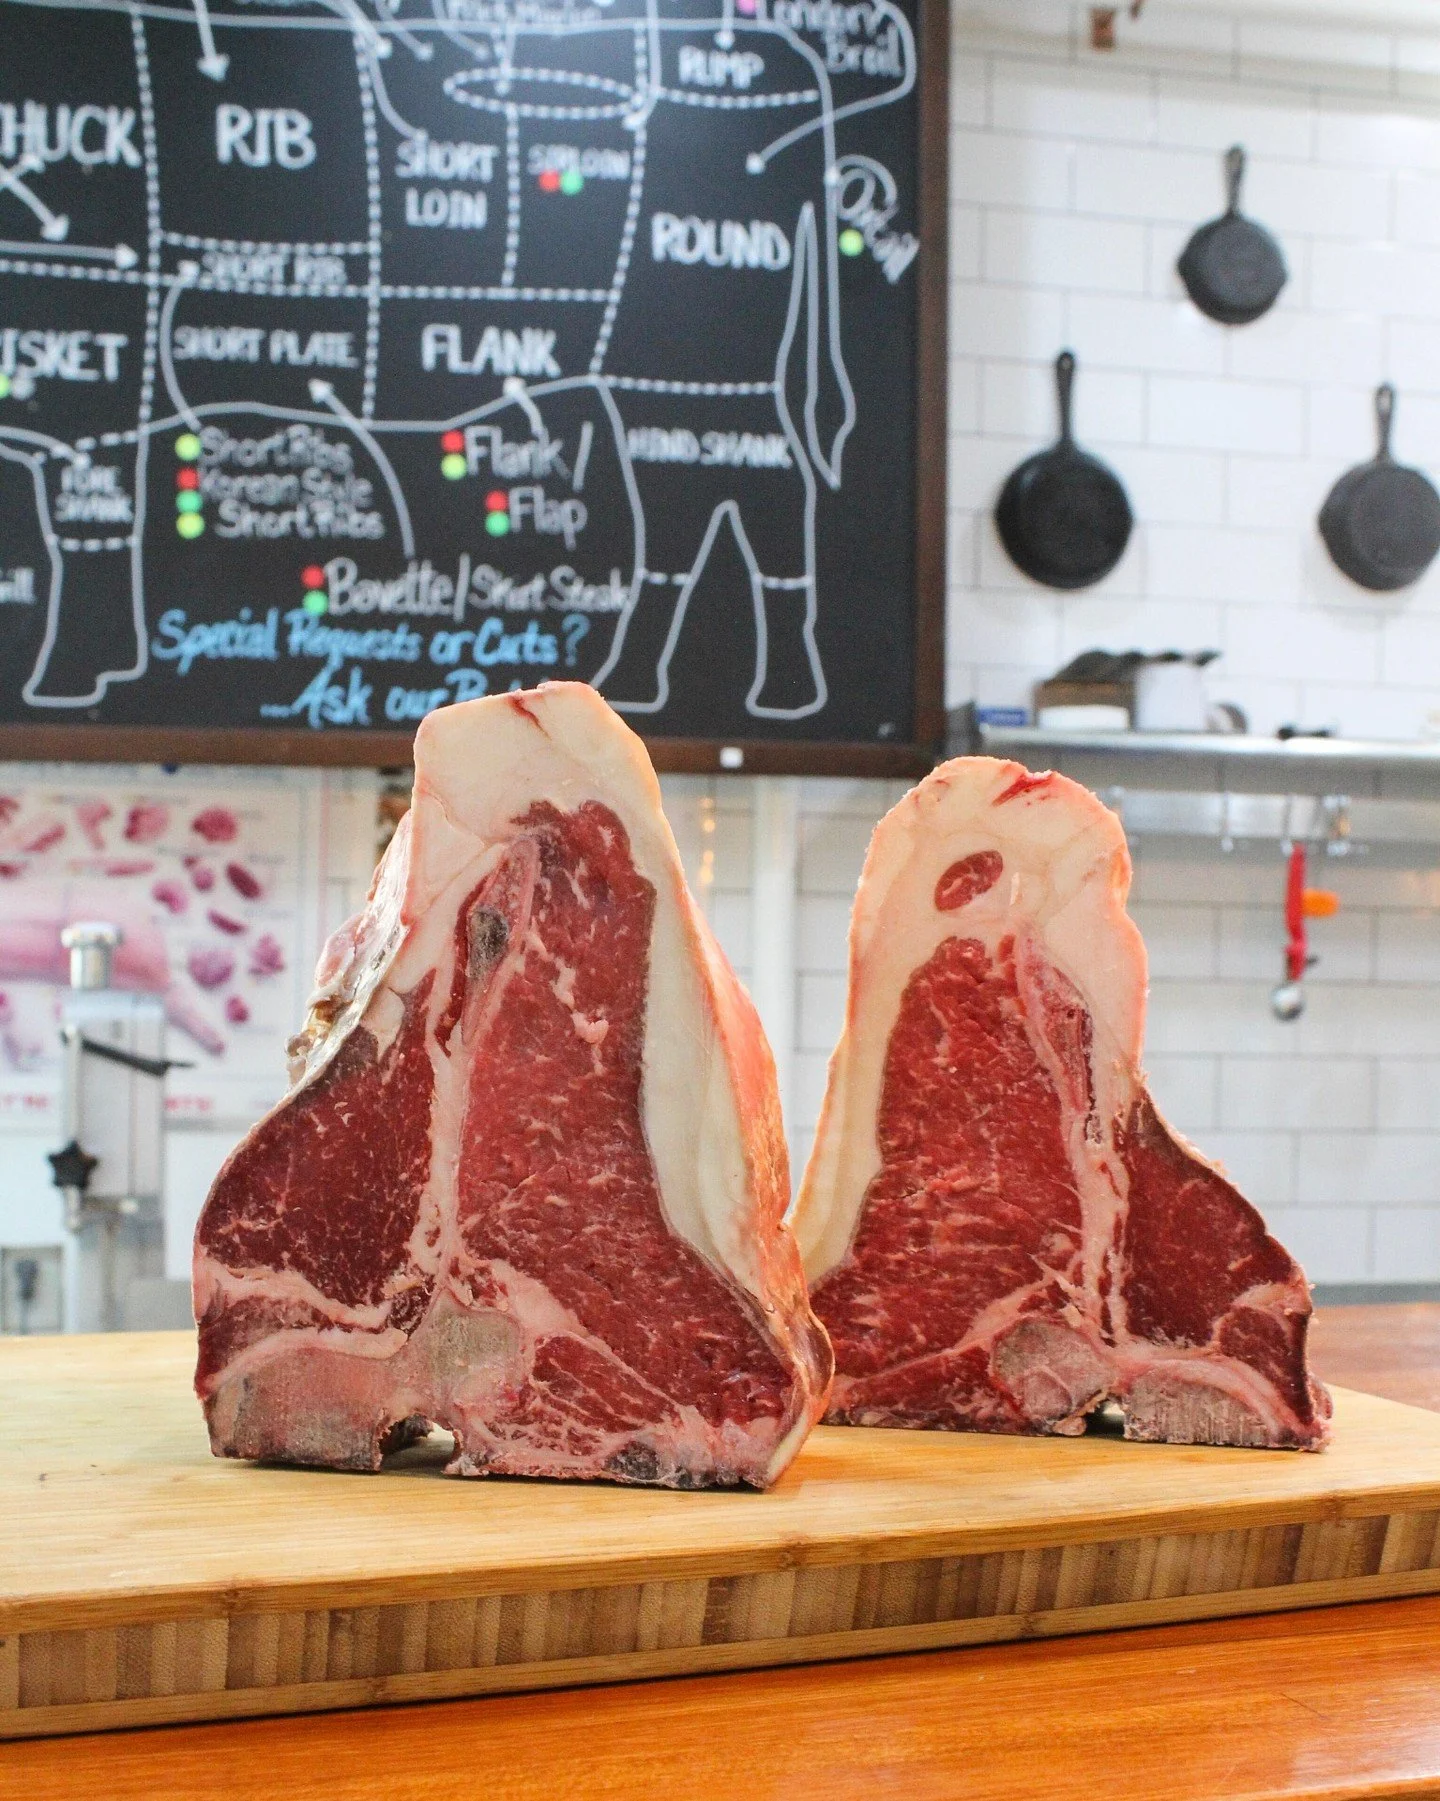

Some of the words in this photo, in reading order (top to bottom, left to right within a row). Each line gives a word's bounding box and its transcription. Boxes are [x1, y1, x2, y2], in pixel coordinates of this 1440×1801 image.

[678, 45, 765, 89] RUMP
[0, 99, 142, 168] HUCK
[216, 103, 316, 169] RIB
[396, 140, 498, 182] SHORT
[405, 187, 489, 229] LOIN
[651, 211, 792, 271] ROUND
[0, 327, 129, 382] ISKET
[173, 326, 265, 364] SHORT
[269, 328, 359, 369] PLATE
[421, 323, 561, 378] FLANK
[508, 487, 588, 551] Flap
[151, 607, 280, 676] Special
[284, 607, 424, 670] Requests
[428, 629, 476, 666] or
[384, 685, 449, 722] our
